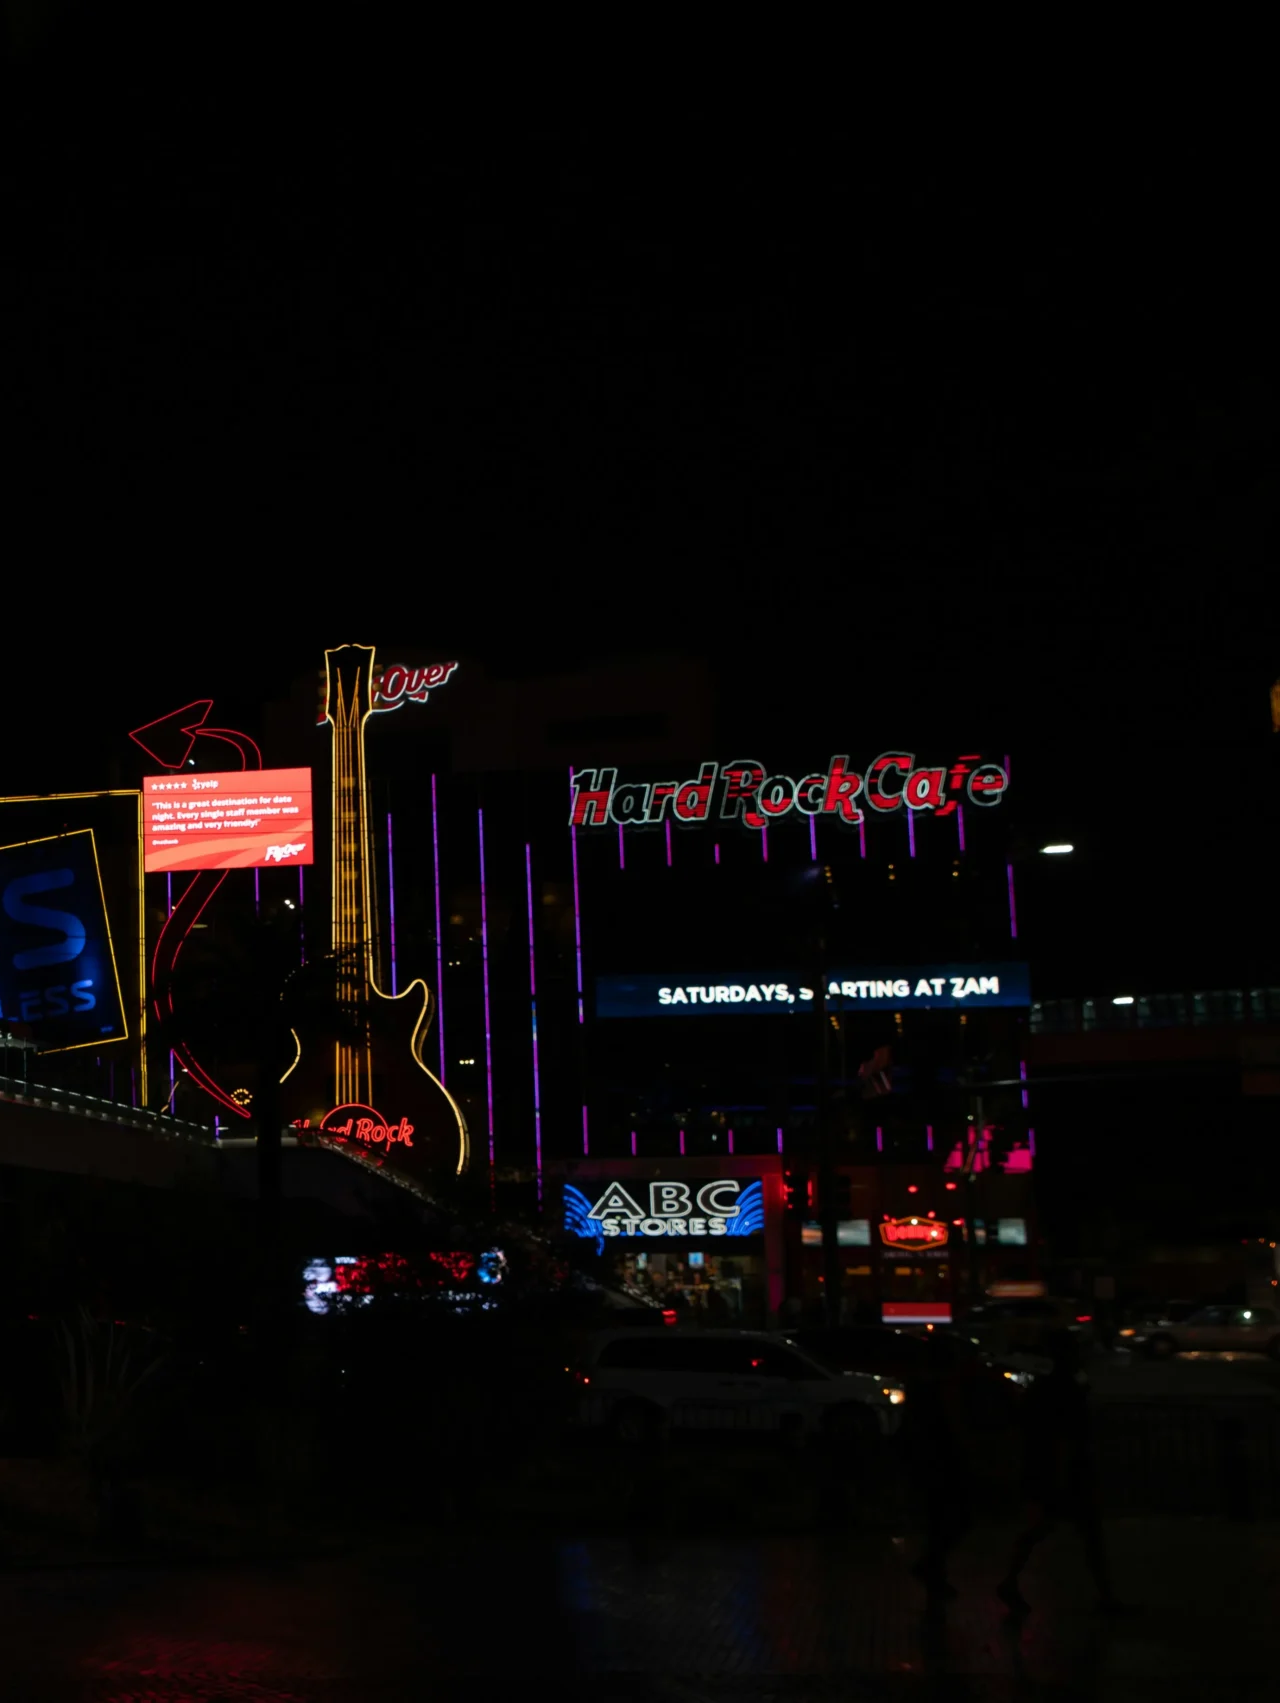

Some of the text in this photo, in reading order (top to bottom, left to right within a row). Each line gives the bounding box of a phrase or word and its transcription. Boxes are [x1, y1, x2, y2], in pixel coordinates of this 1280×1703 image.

[188, 800, 210, 810] great
[211, 797, 258, 807] destination
[259, 796, 271, 804] for
[272, 795, 292, 803] date
[569, 762, 718, 827] Hard
[721, 755, 864, 829] Rock
[152, 806, 299, 822] night. Every single staff member was
[152, 822, 186, 832] amazing
[187, 821, 203, 830] and
[204, 821, 222, 830] very
[658, 983, 796, 1004] SATURDAYS,
[798, 979, 911, 1001] SARTING
[914, 978, 946, 996] AT
[355, 1117, 415, 1148] Rock
[587, 1180, 741, 1219] ABC
[601, 1217, 728, 1236] STORES
